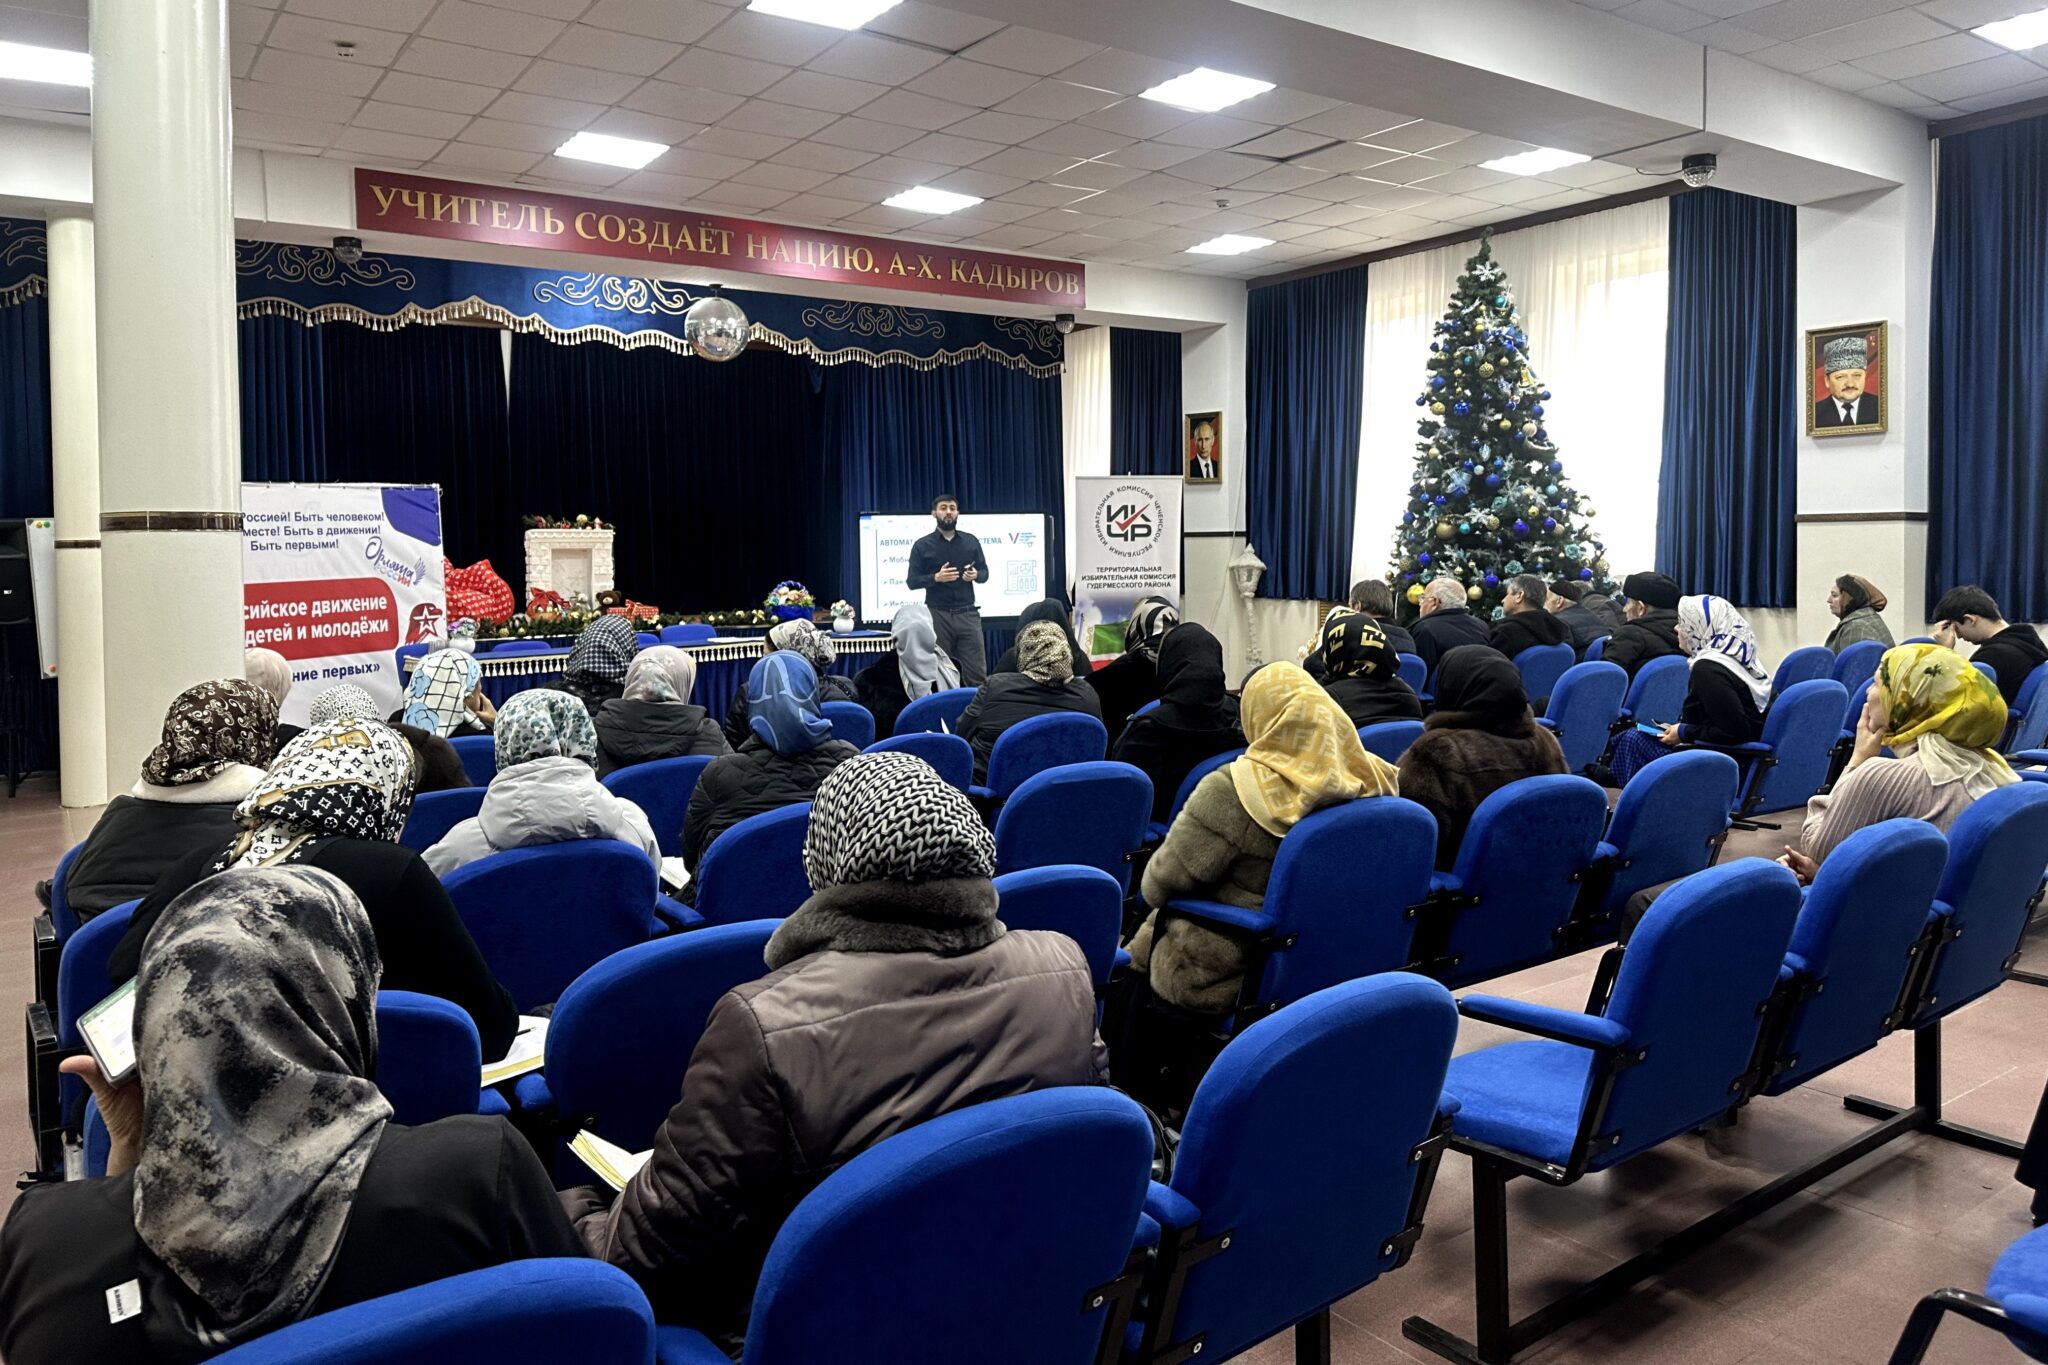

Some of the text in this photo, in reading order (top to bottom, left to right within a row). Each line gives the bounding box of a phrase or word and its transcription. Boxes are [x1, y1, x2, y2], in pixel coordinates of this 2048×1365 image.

[369, 184, 1080, 296] УЧИТЕЛЬ СОЗДАЁТ НАЦИЮ. А-Х. КАДЫРОВ
[1116, 485, 1154, 500] КОМИССИЯ
[294, 511, 324, 522] Быть
[326, 511, 385, 521] человеком!
[284, 525, 314, 536] Быть
[316, 527, 324, 536] в
[326, 525, 381, 537] движении!
[250, 538, 339, 552] Быть первыми!
[1086, 582, 1143, 590] ГУДЕРМЕССКОГО
[311, 596, 388, 618] движение
[245, 616, 389, 648] детей и молодёжи
[322, 662, 381, 680] первых»
